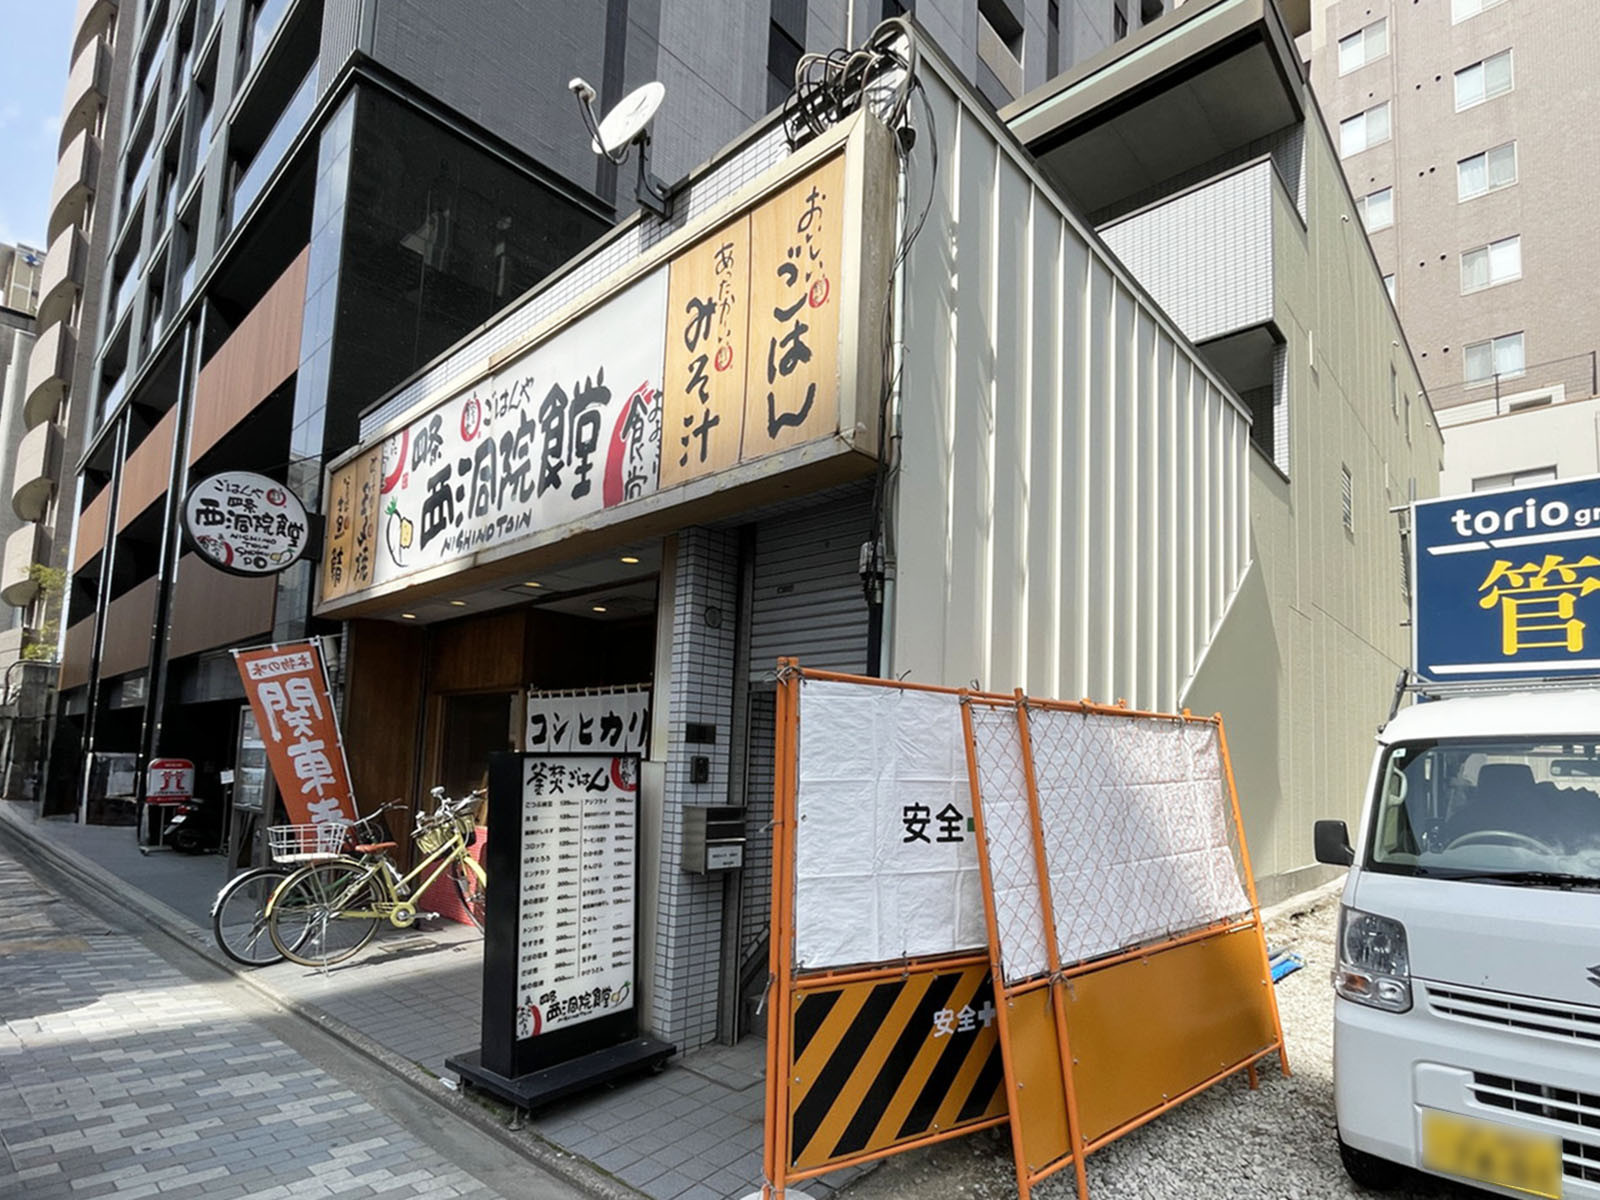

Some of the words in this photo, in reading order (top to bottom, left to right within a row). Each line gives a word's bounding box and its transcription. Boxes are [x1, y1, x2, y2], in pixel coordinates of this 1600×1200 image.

[797, 185, 827, 282] おいしい
[714, 242, 736, 344] あったかい
[767, 245, 816, 440] ごはん
[483, 376, 534, 427] ごはんや
[679, 296, 720, 467] みそ汁
[412, 413, 444, 472] 四条
[420, 366, 612, 550] 西洞院食堂
[214, 479, 264, 500] ごはんや
[1451, 498, 1569, 537] torio
[1478, 554, 1600, 656] 管
[531, 708, 648, 748] コシヒカリ
[902, 802, 965, 844] 安全
[933, 1004, 977, 1038] 安全
